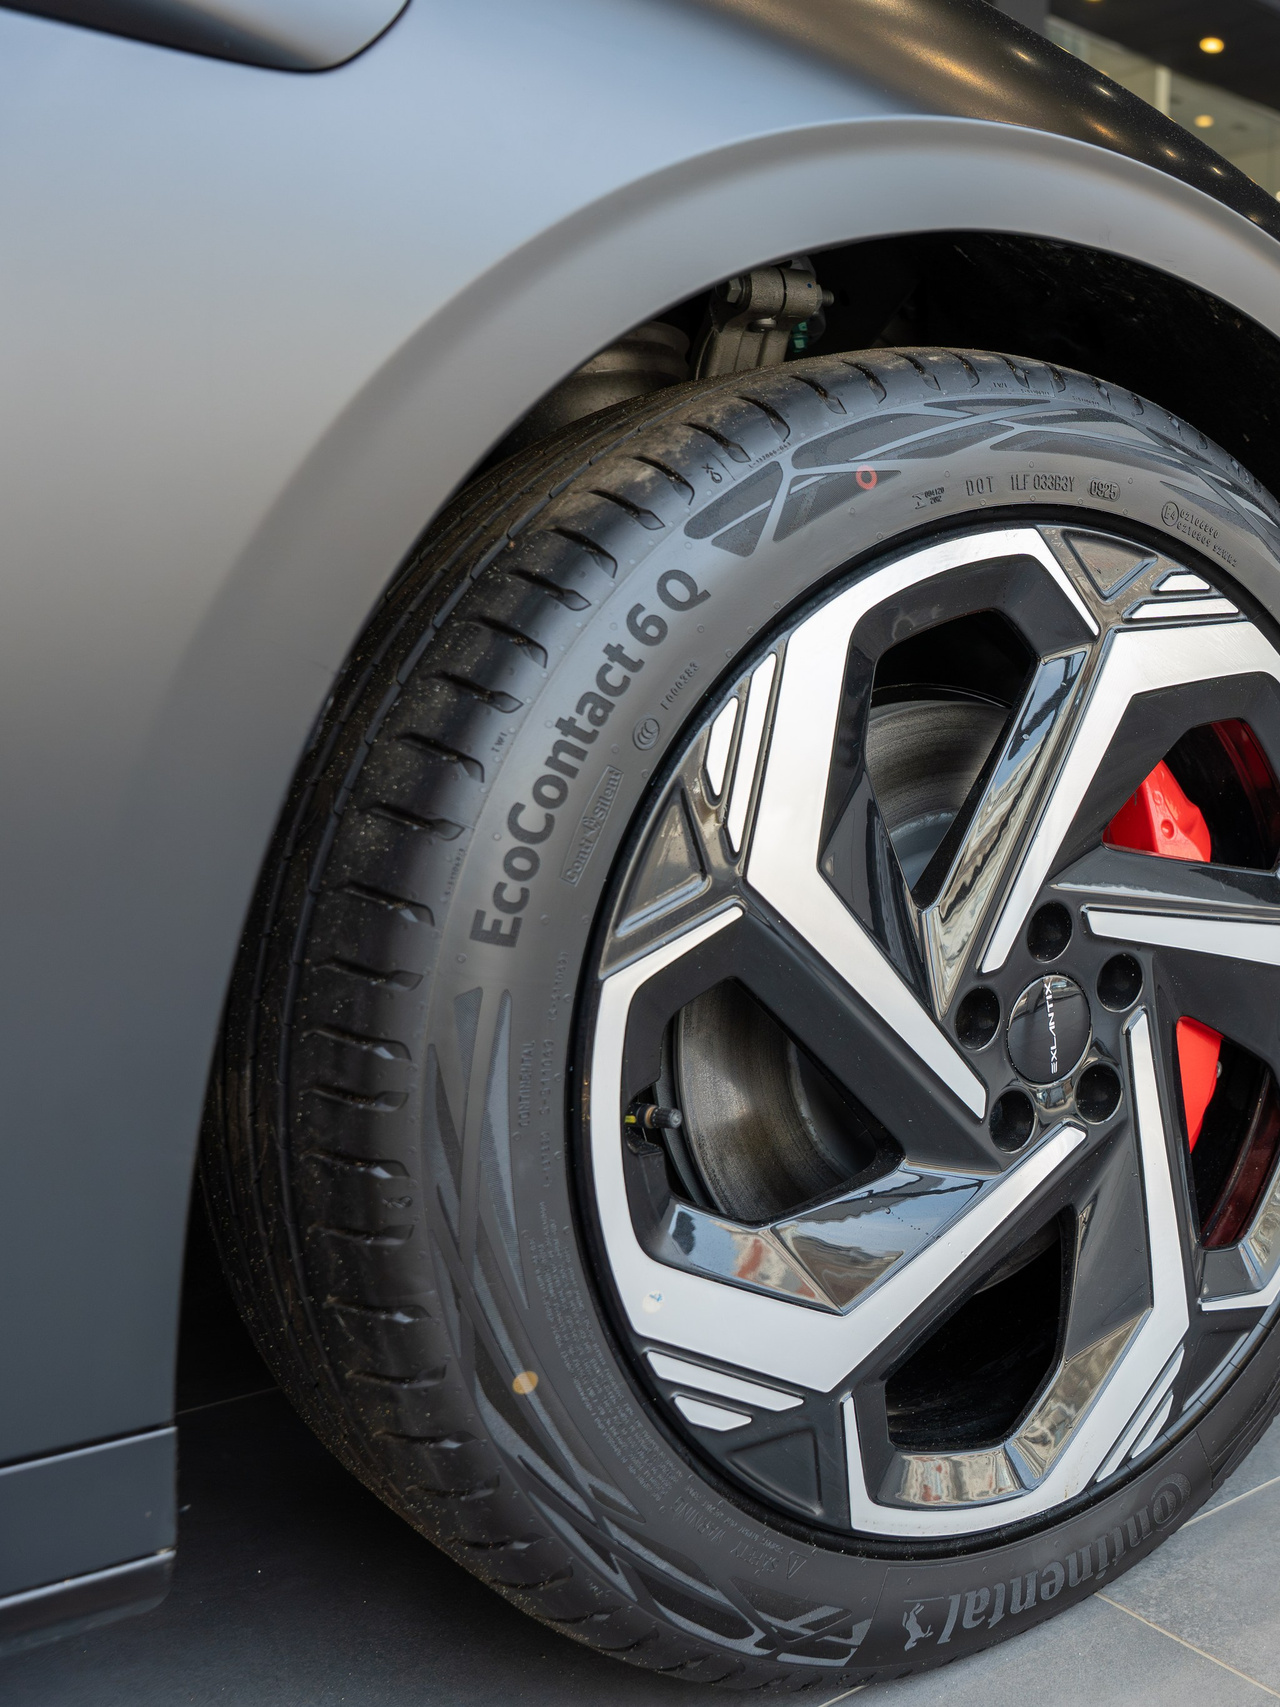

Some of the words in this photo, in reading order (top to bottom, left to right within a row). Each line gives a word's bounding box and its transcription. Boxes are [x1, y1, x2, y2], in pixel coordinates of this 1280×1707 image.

[966, 476, 993, 496] DOT
[1011, 474, 1030, 491] 1LF
[1089, 479, 1118, 500] 0925
[469, 640, 646, 948] EcoContact
[626, 602, 669, 647] 6
[656, 568, 712, 613] Q
[1042, 982, 1058, 1075] EXLANTIX
[517, 1039, 535, 1128] CONTINENTAL
[671, 1495, 727, 1542] WARNING
[730, 1541, 780, 1574] SAFETY
[937, 1472, 1193, 1645] Continental
